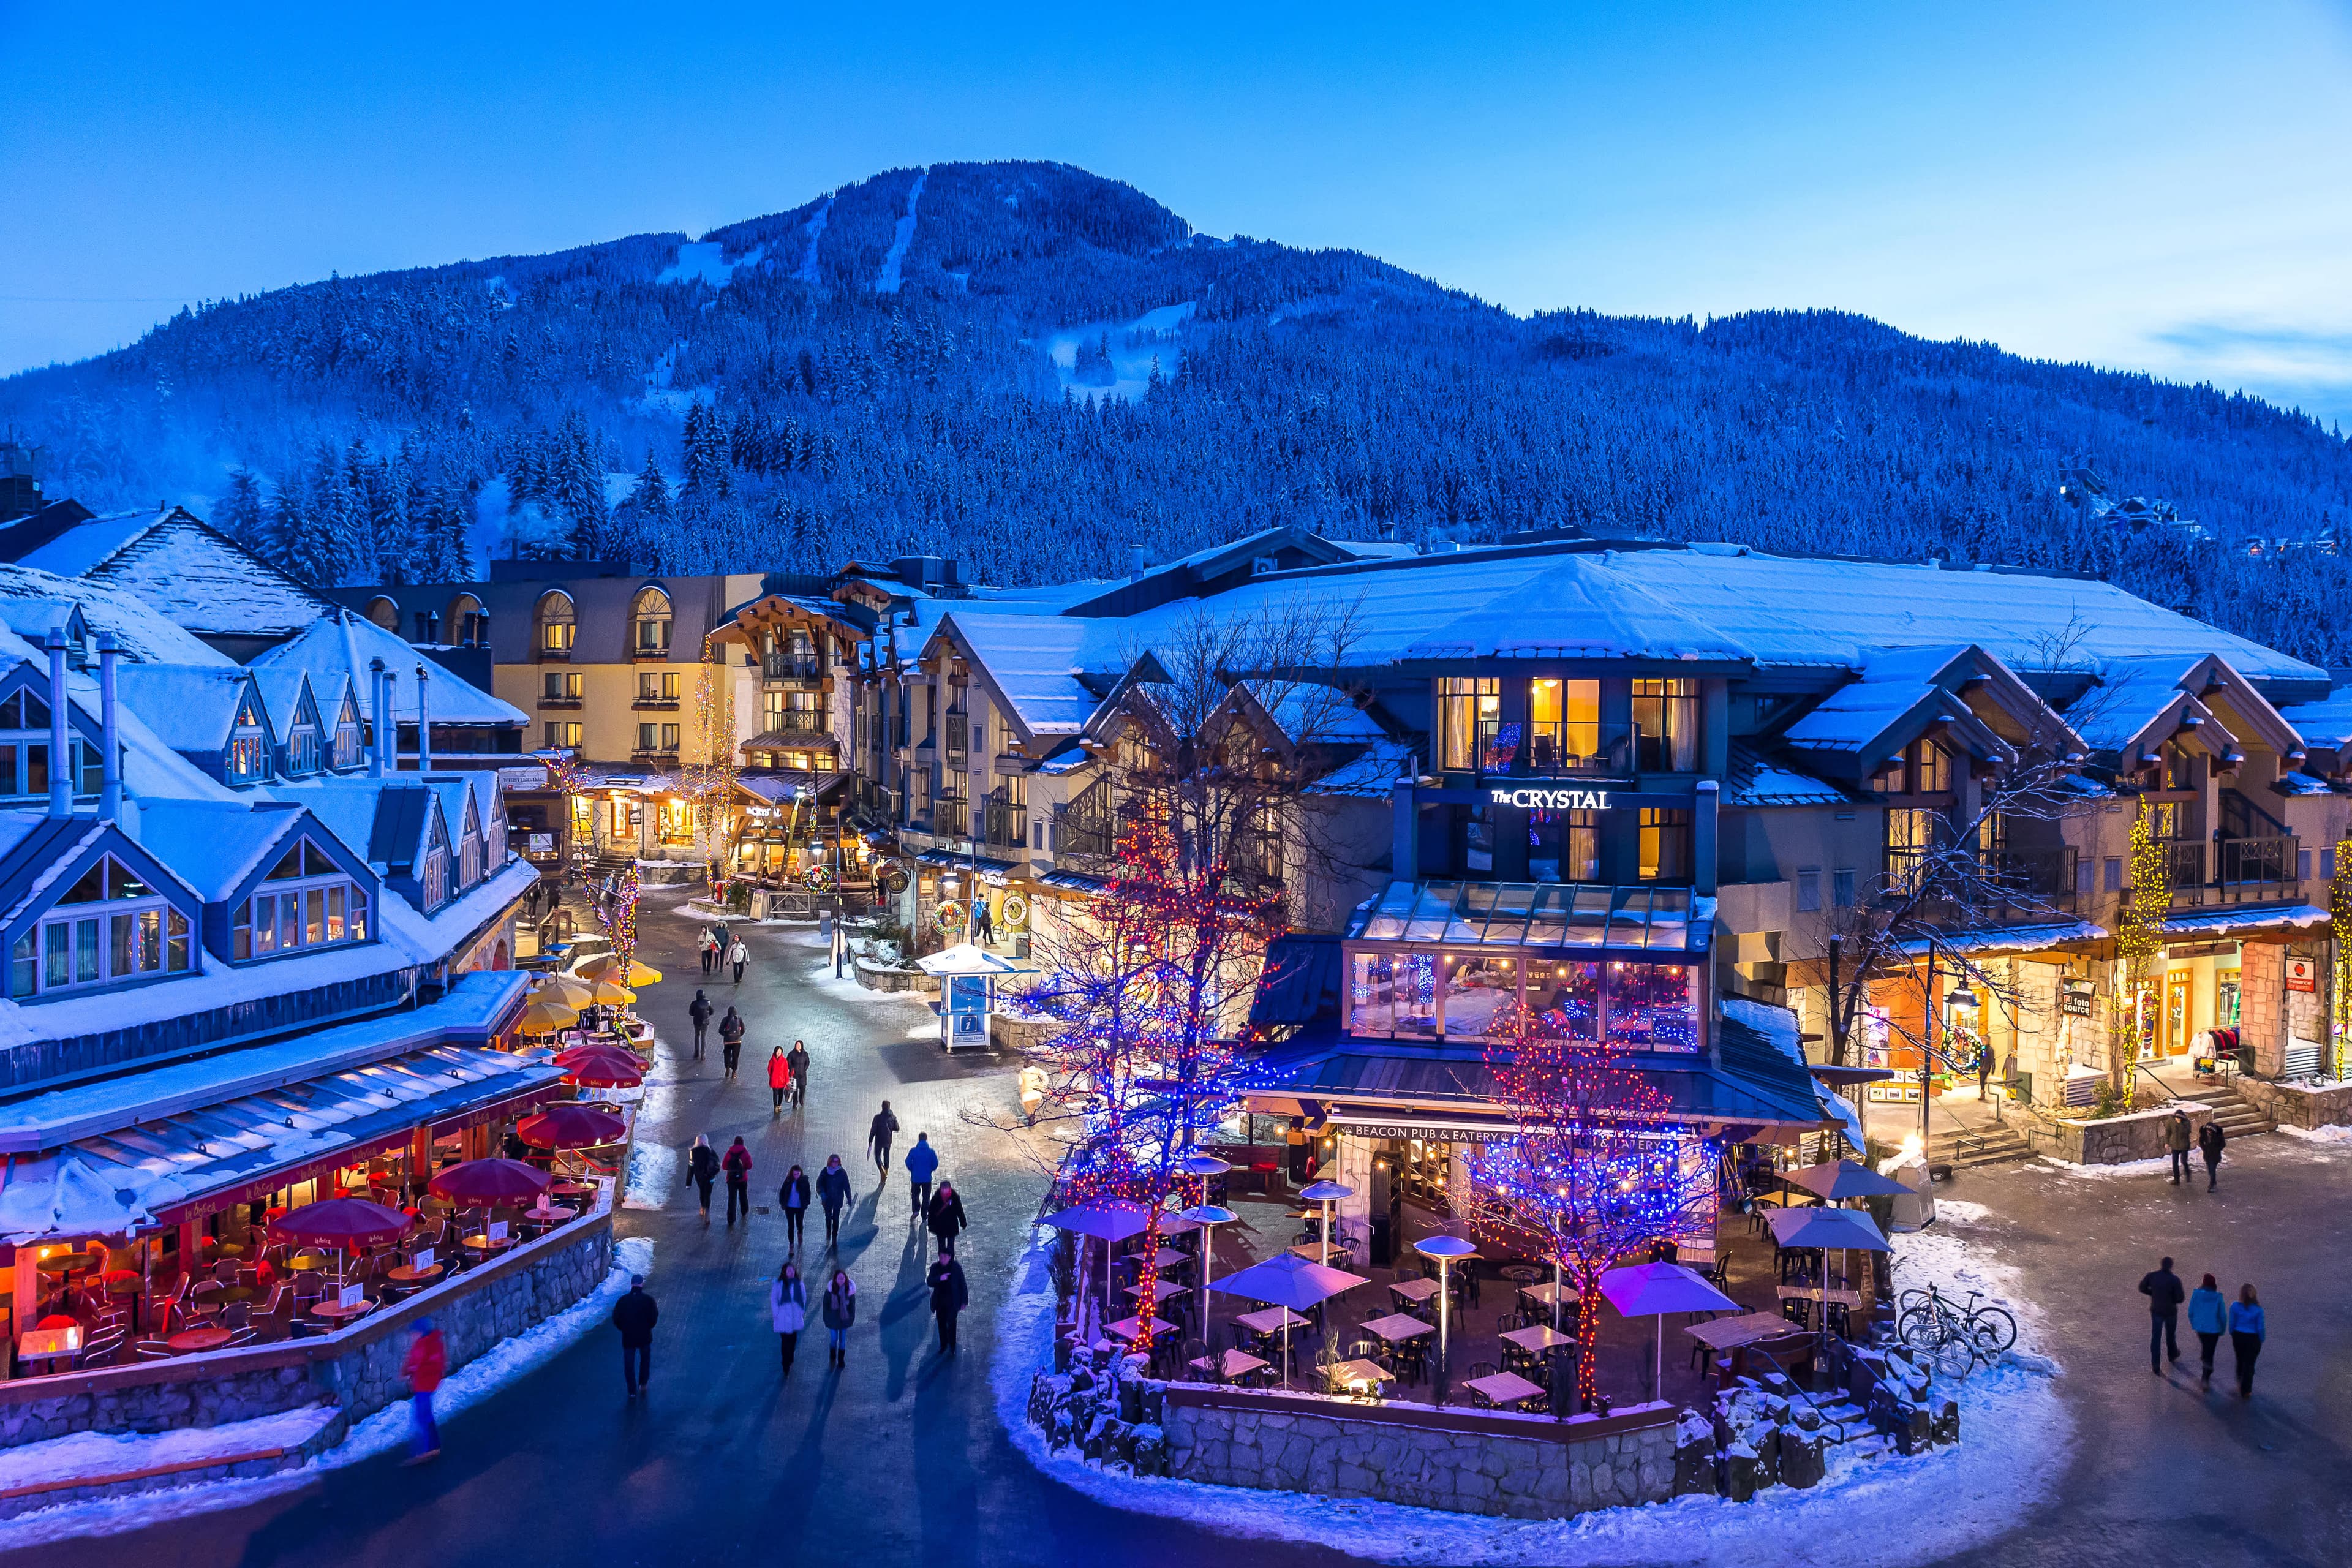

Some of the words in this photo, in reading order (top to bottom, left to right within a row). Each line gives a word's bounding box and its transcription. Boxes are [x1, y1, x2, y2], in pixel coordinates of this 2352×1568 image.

[1491, 790, 1512, 803] The
[1512, 789, 1612, 809] CRYSTAL
[2074, 998, 2089, 1007] foto
[2064, 1005, 2090, 1014] source
[1356, 1126, 1407, 1137] BEACON
[1411, 1128, 1436, 1139] PUB
[1439, 1129, 1449, 1139] &
[1453, 1131, 1498, 1142] EATERY
[1600, 1138, 1608, 1147] &
